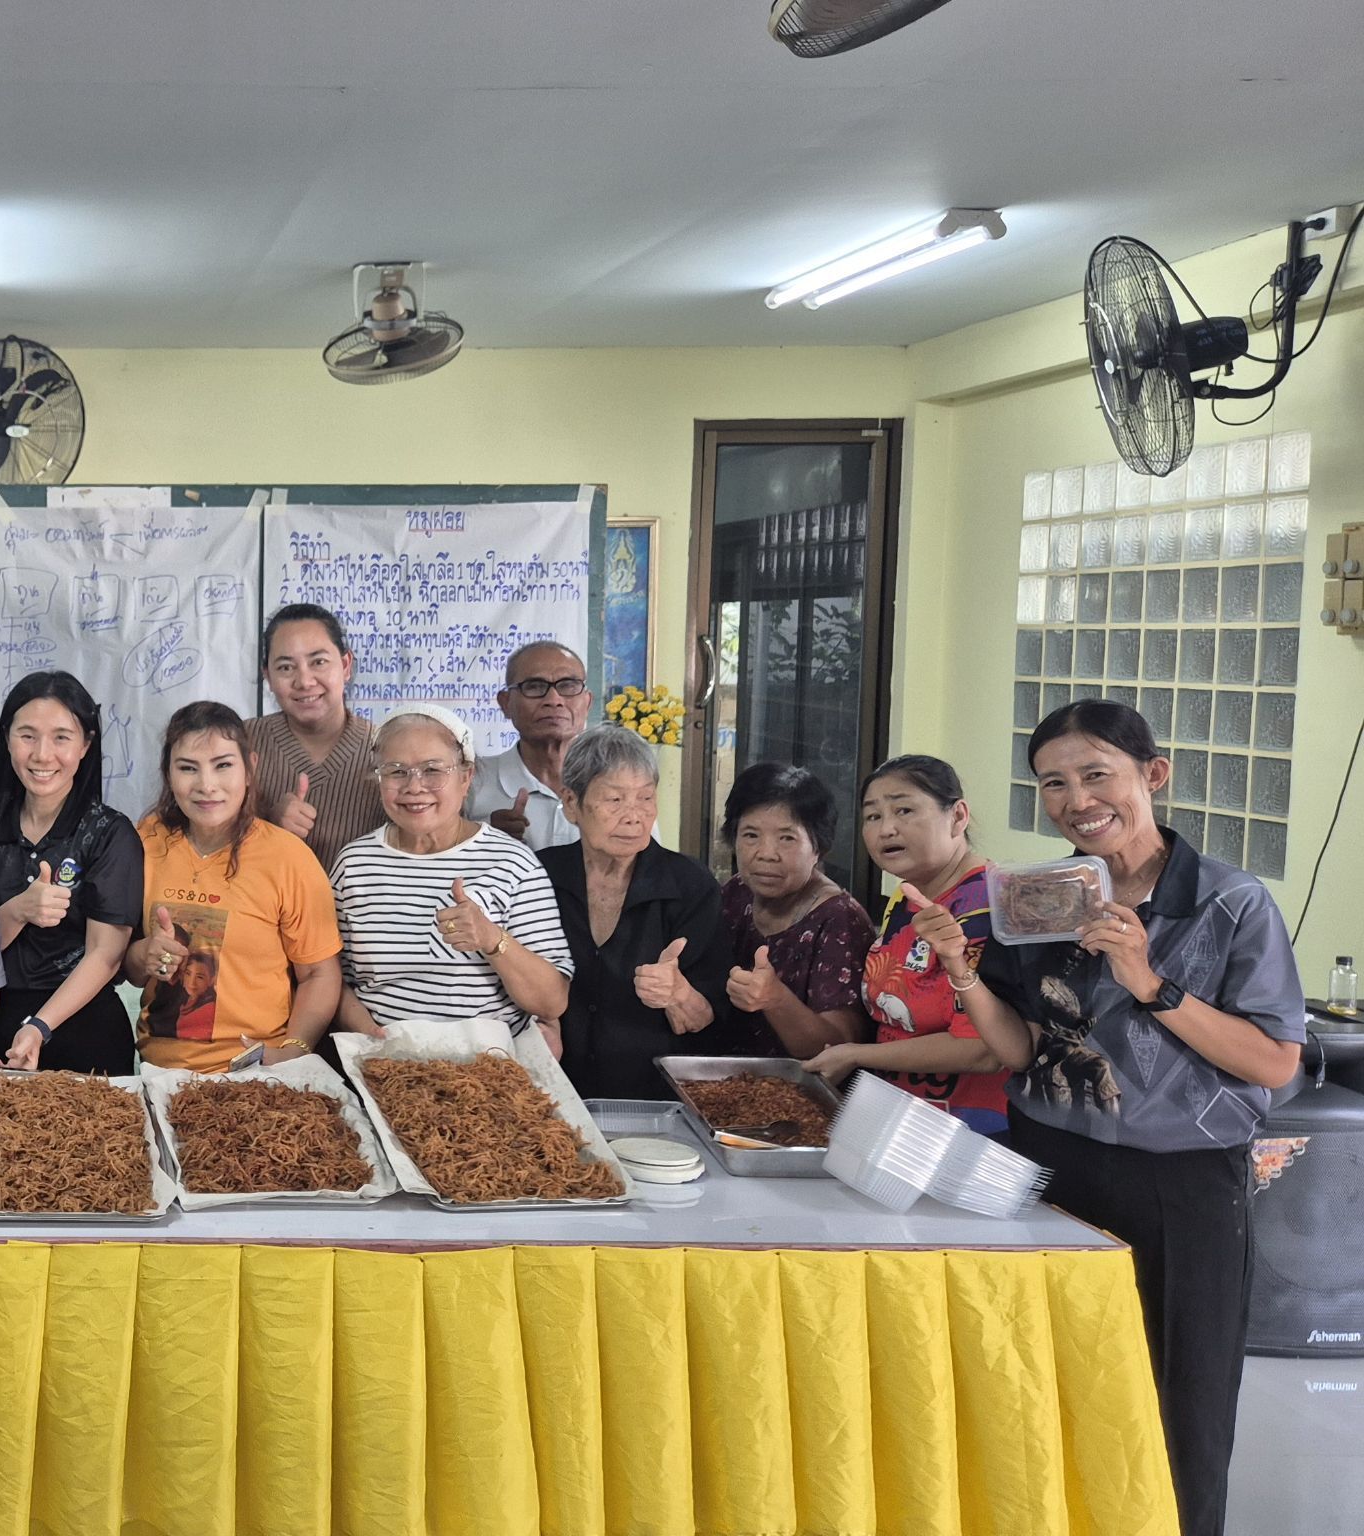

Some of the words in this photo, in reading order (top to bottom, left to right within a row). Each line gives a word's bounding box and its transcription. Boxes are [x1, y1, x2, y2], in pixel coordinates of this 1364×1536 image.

[406, 506, 465, 538] หมูฝอย
[289, 531, 331, 561] วิธีทำ
[407, 603, 439, 627] นาที
[177, 889, 186, 900] S
[198, 892, 207, 903] D
